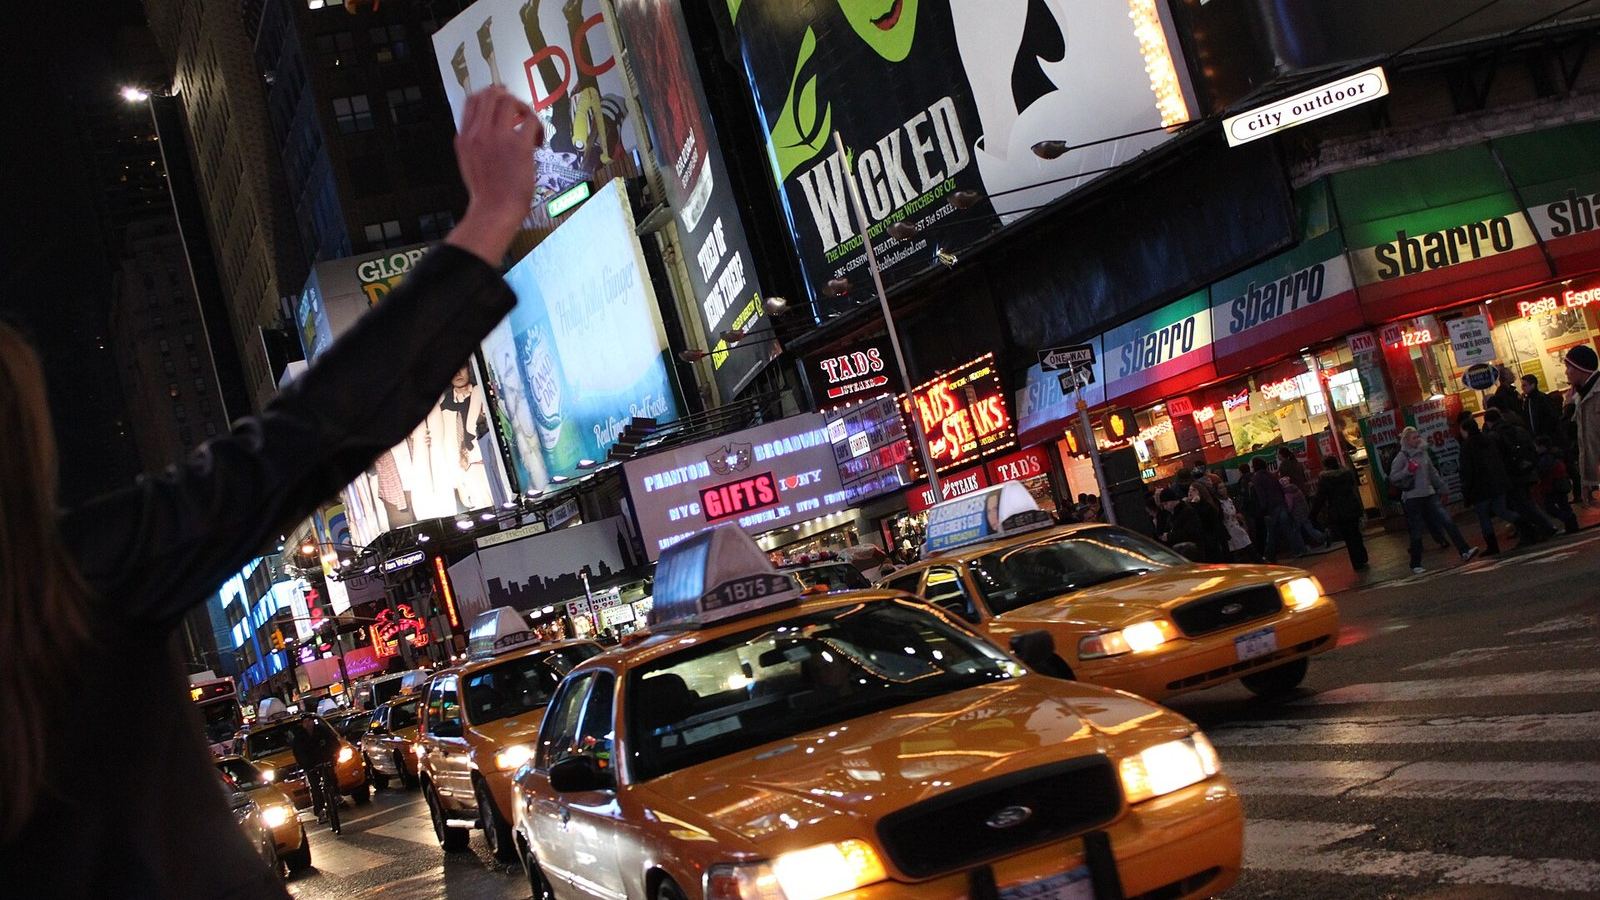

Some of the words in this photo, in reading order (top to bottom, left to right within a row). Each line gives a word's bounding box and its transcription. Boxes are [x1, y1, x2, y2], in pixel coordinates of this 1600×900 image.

[1247, 111, 1281, 131] city
[1292, 82, 1366, 116] outdoor
[825, 247, 840, 264] THE
[838, 234, 866, 258] UNTOLD
[867, 221, 885, 240] TORY
[892, 210, 906, 226] THE
[904, 192, 937, 217] WITCHES
[935, 188, 945, 204] OF
[942, 178, 957, 197] OZ
[713, 216, 728, 258] OF
[846, 252, 870, 273] GERSHW
[935, 200, 959, 221] STREE
[1374, 215, 1514, 281] sbarro
[868, 238, 928, 277] WkedtheMusical.com
[1230, 263, 1324, 334] sbarro
[1518, 296, 1557, 318] Pasta
[1120, 315, 1195, 378] sbarro
[1351, 334, 1375, 352] ATM
[1394, 329, 1432, 350] izza
[820, 347, 885, 384] TADS
[1049, 352, 1068, 366] ONE
[1069, 350, 1088, 362] WAY
[842, 378, 876, 396] STEAKS
[1170, 400, 1191, 416] ATM
[643, 460, 711, 493] PHANTOM
[753, 427, 831, 462] BROADWAY
[997, 455, 1042, 482] TAD'S
[798, 469, 822, 487] NY
[704, 476, 773, 519] GIFTS
[668, 503, 701, 522] NYC
[396, 553, 423, 567] Wagner
[725, 578, 768, 604] 1B75
[567, 602, 577, 616] 5
